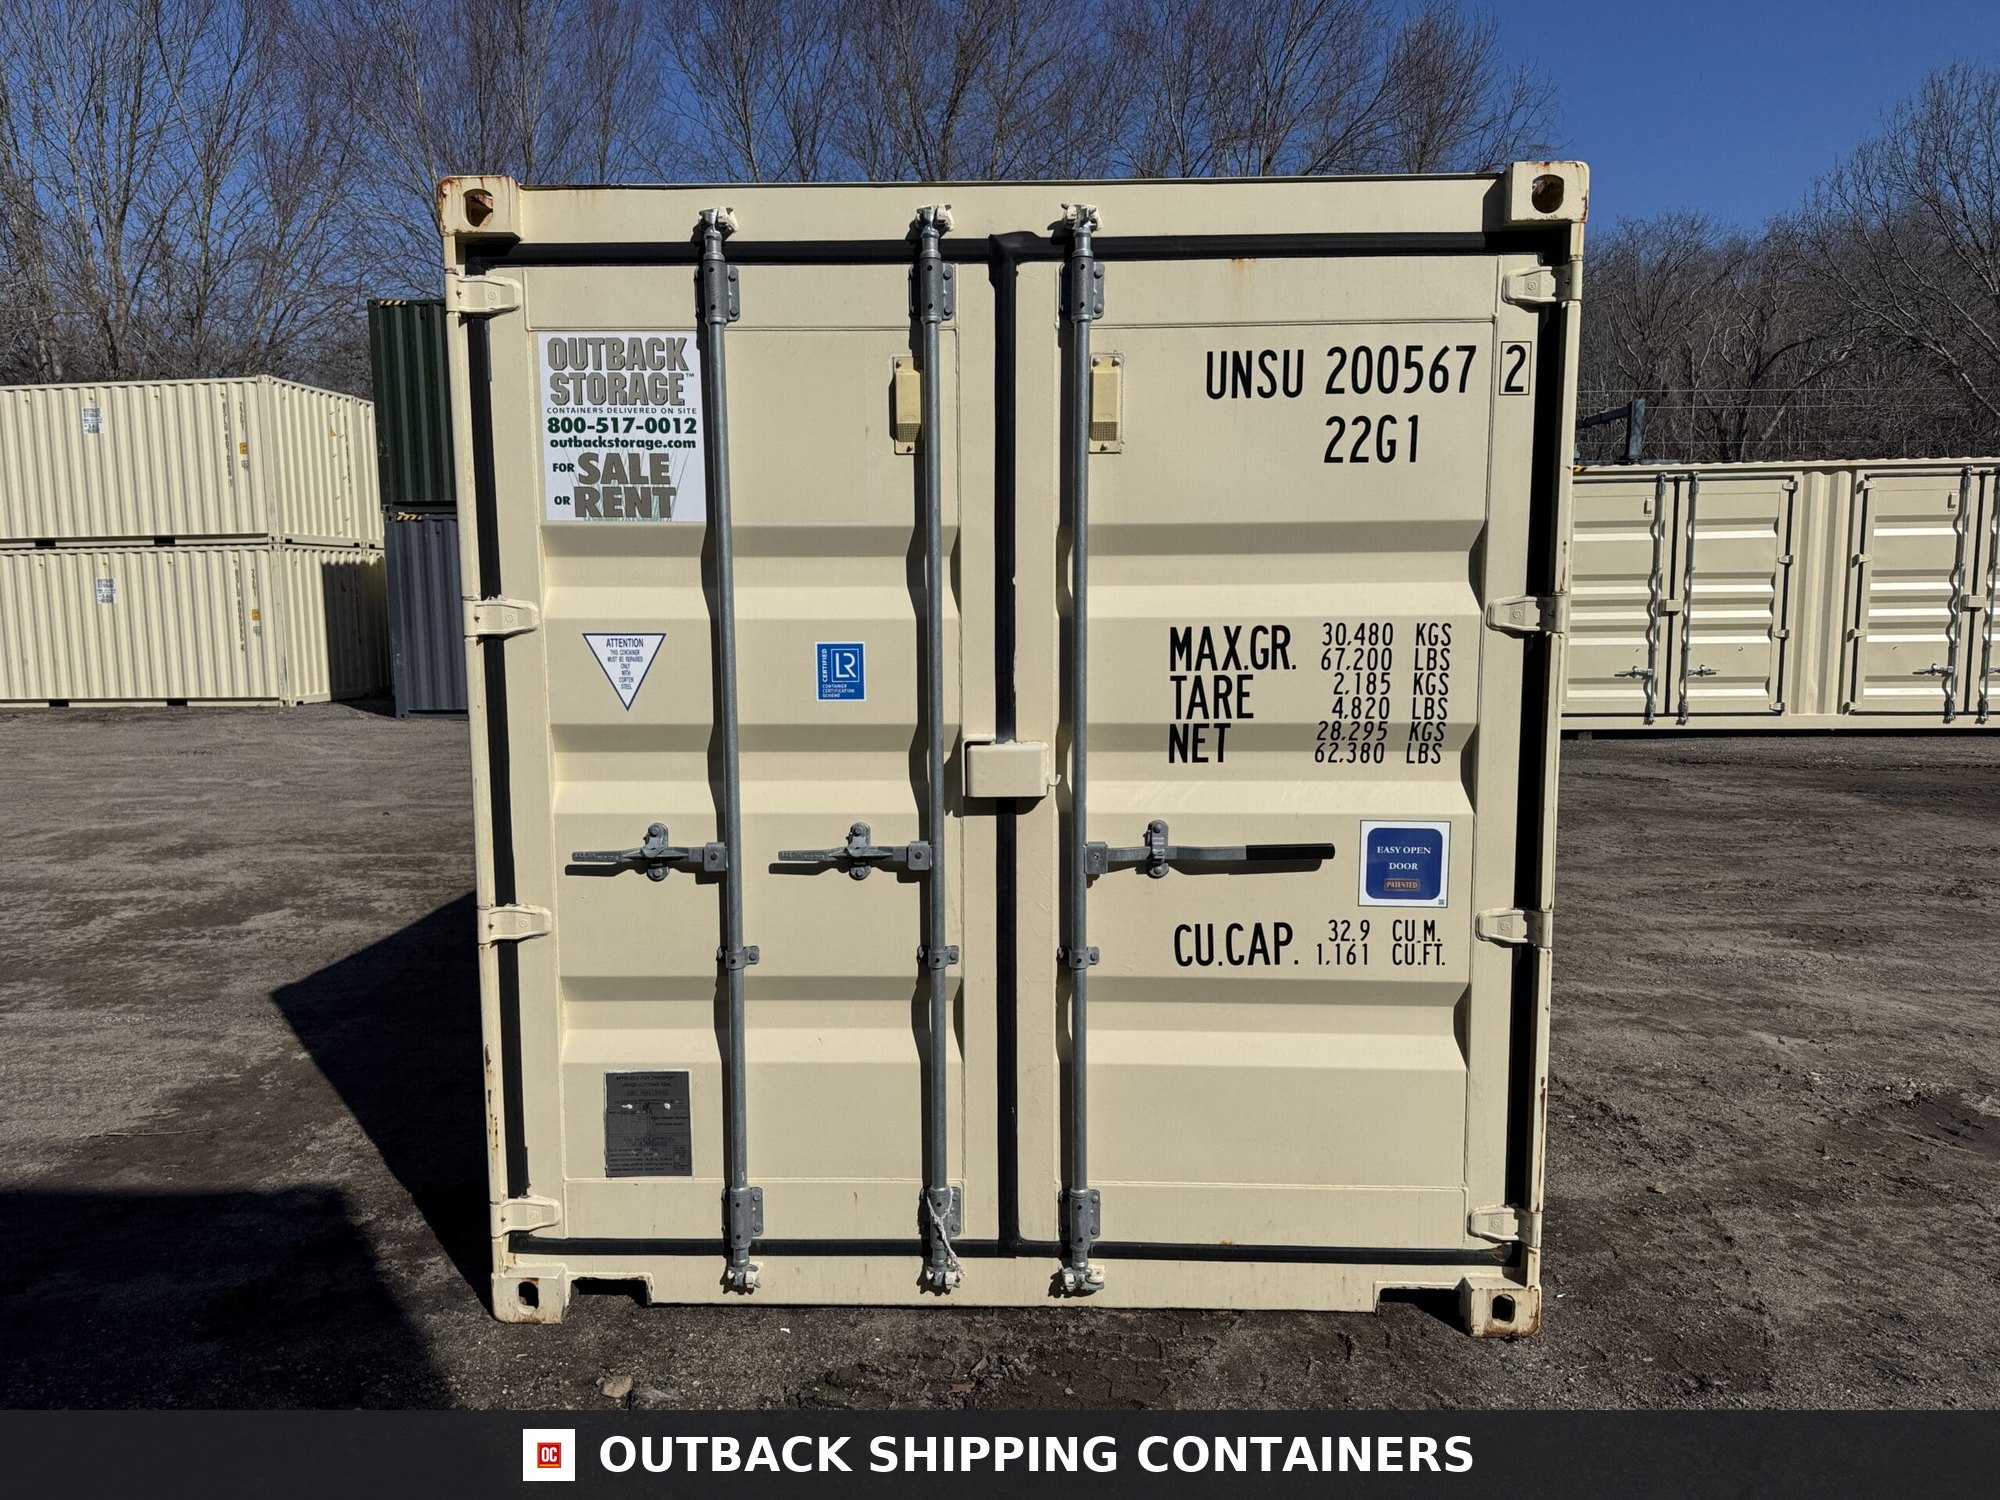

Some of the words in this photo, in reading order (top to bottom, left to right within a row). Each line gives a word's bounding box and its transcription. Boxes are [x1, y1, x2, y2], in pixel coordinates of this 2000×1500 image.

[547, 337, 689, 371] OUTBACK
[1206, 350, 1304, 399] UNSU
[1325, 345, 1477, 395] 200567
[1504, 344, 1527, 393] 2
[549, 372, 686, 406] STORAGE
[547, 417, 697, 434] 800-517-0012
[1324, 414, 1419, 463] 22G1
[550, 435, 697, 450] outbackstorage.com
[552, 463, 575, 473] FOR
[577, 452, 671, 485] SALE
[554, 495, 570, 505] OR
[574, 487, 677, 518] RENT
[606, 638, 644, 647] ATTENTION
[1170, 624, 1297, 672] MAX.GR.
[1321, 622, 1394, 646] 30,480
[1415, 622, 1452, 646] KGS
[1320, 647, 1393, 671] 67,200
[1414, 647, 1451, 671] LBS
[1170, 674, 1254, 720] TARE
[1333, 671, 1391, 696] 2,185
[1413, 671, 1449, 696] KGS
[1332, 696, 1390, 720] 4,820
[1412, 697, 1448, 720] LBS
[1168, 722, 1232, 764] NET
[1316, 720, 1388, 742] 28,295
[1408, 721, 1447, 742] KGS
[1314, 742, 1385, 764] 62,380
[1406, 742, 1442, 764] LBS
[1377, 846, 1401, 854] EASY
[1402, 846, 1431, 854] OPEN
[1389, 862, 1418, 870] DOOR
[1386, 881, 1418, 889] PATENTED
[1174, 922, 1299, 967] CU.CAP.
[1328, 919, 1370, 942] 32.9
[1316, 943, 1368, 965] 1,161
[1392, 943, 1446, 966] CU.FT.
